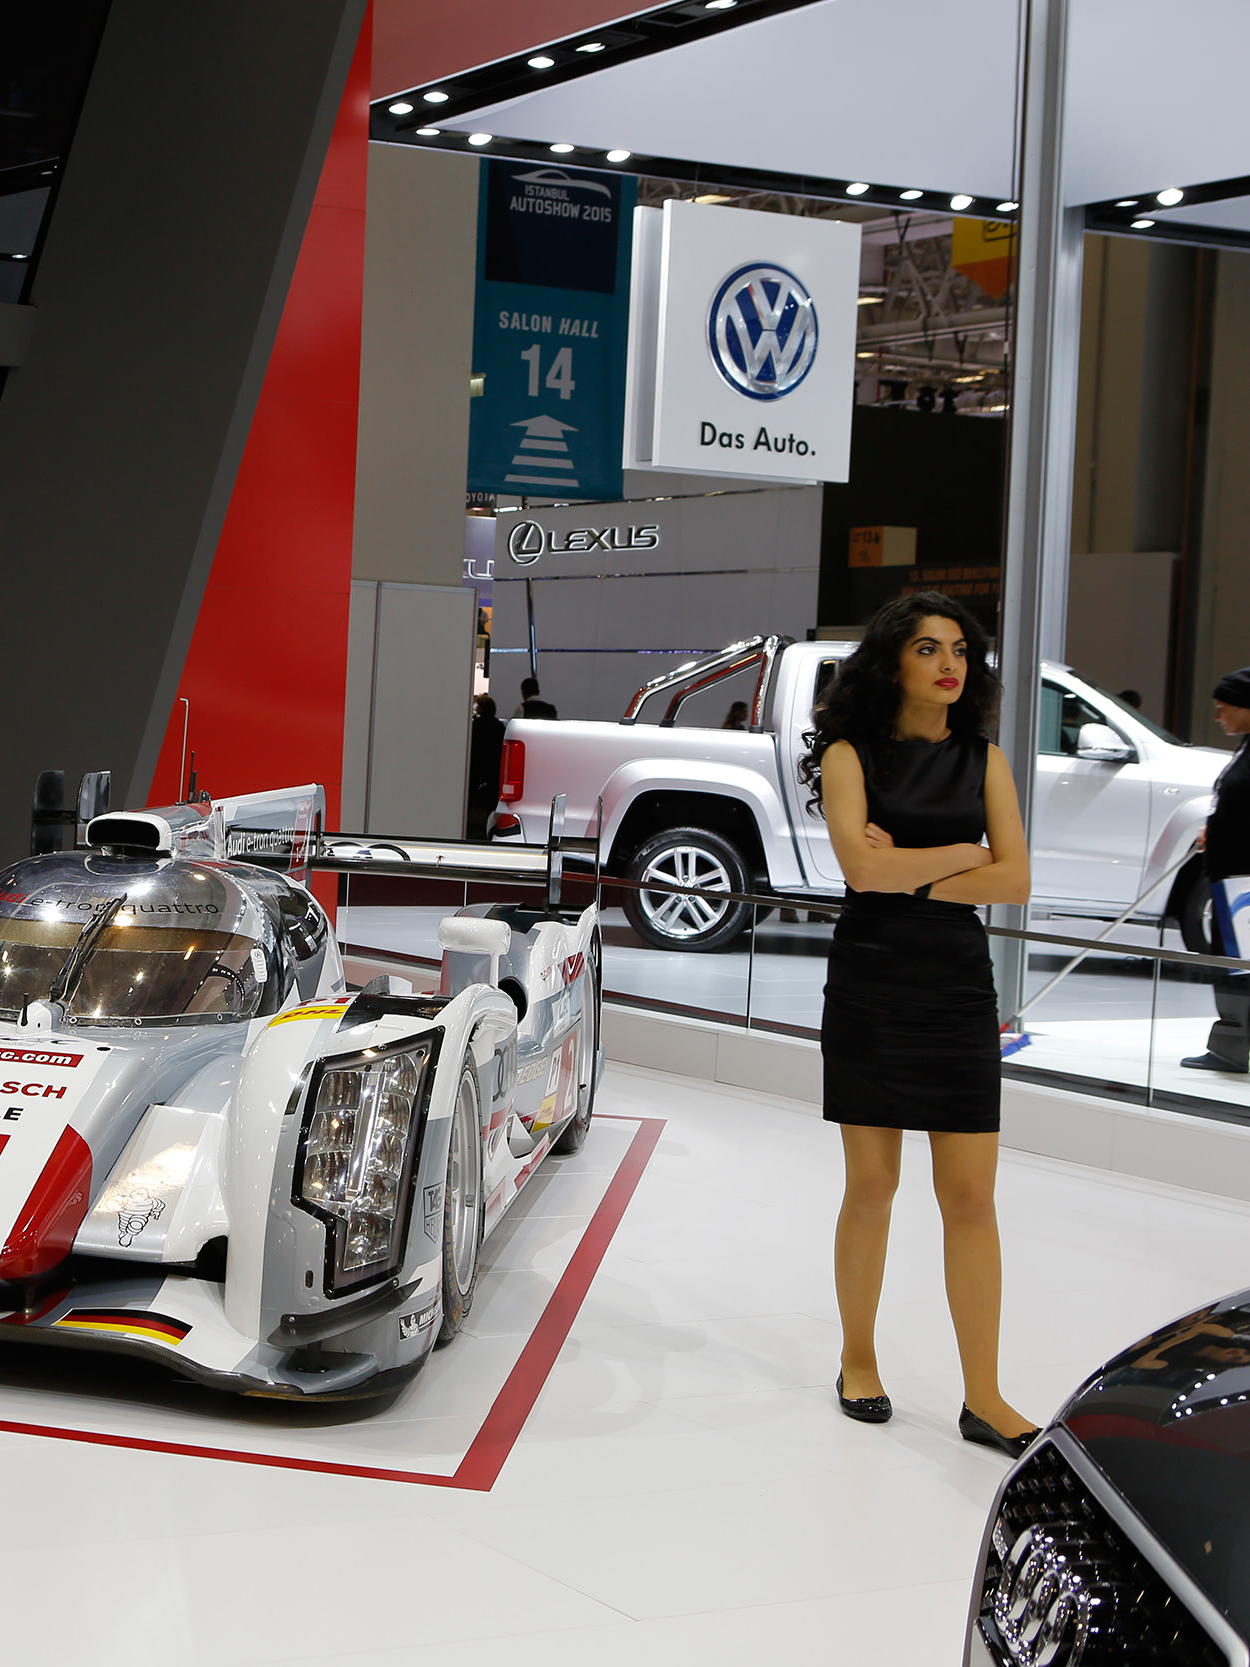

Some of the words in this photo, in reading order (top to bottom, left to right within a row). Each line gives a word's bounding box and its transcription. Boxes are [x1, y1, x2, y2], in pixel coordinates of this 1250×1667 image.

[525, 185, 569, 201] ISTANBUL
[510, 196, 580, 218] AUTOSHOW
[582, 205, 612, 223] 2015
[498, 311, 552, 334] SALON
[558, 317, 599, 338] HALL
[521, 343, 576, 400] 14
[700, 421, 745, 450] Das
[752, 427, 817, 456] Auto.
[548, 524, 660, 555] LEXUS
[226, 832, 246, 858] Audi
[246, 832, 269, 852] e-tron
[120, 903, 219, 916] quattro
[427, 1187, 442, 1213] TAG
